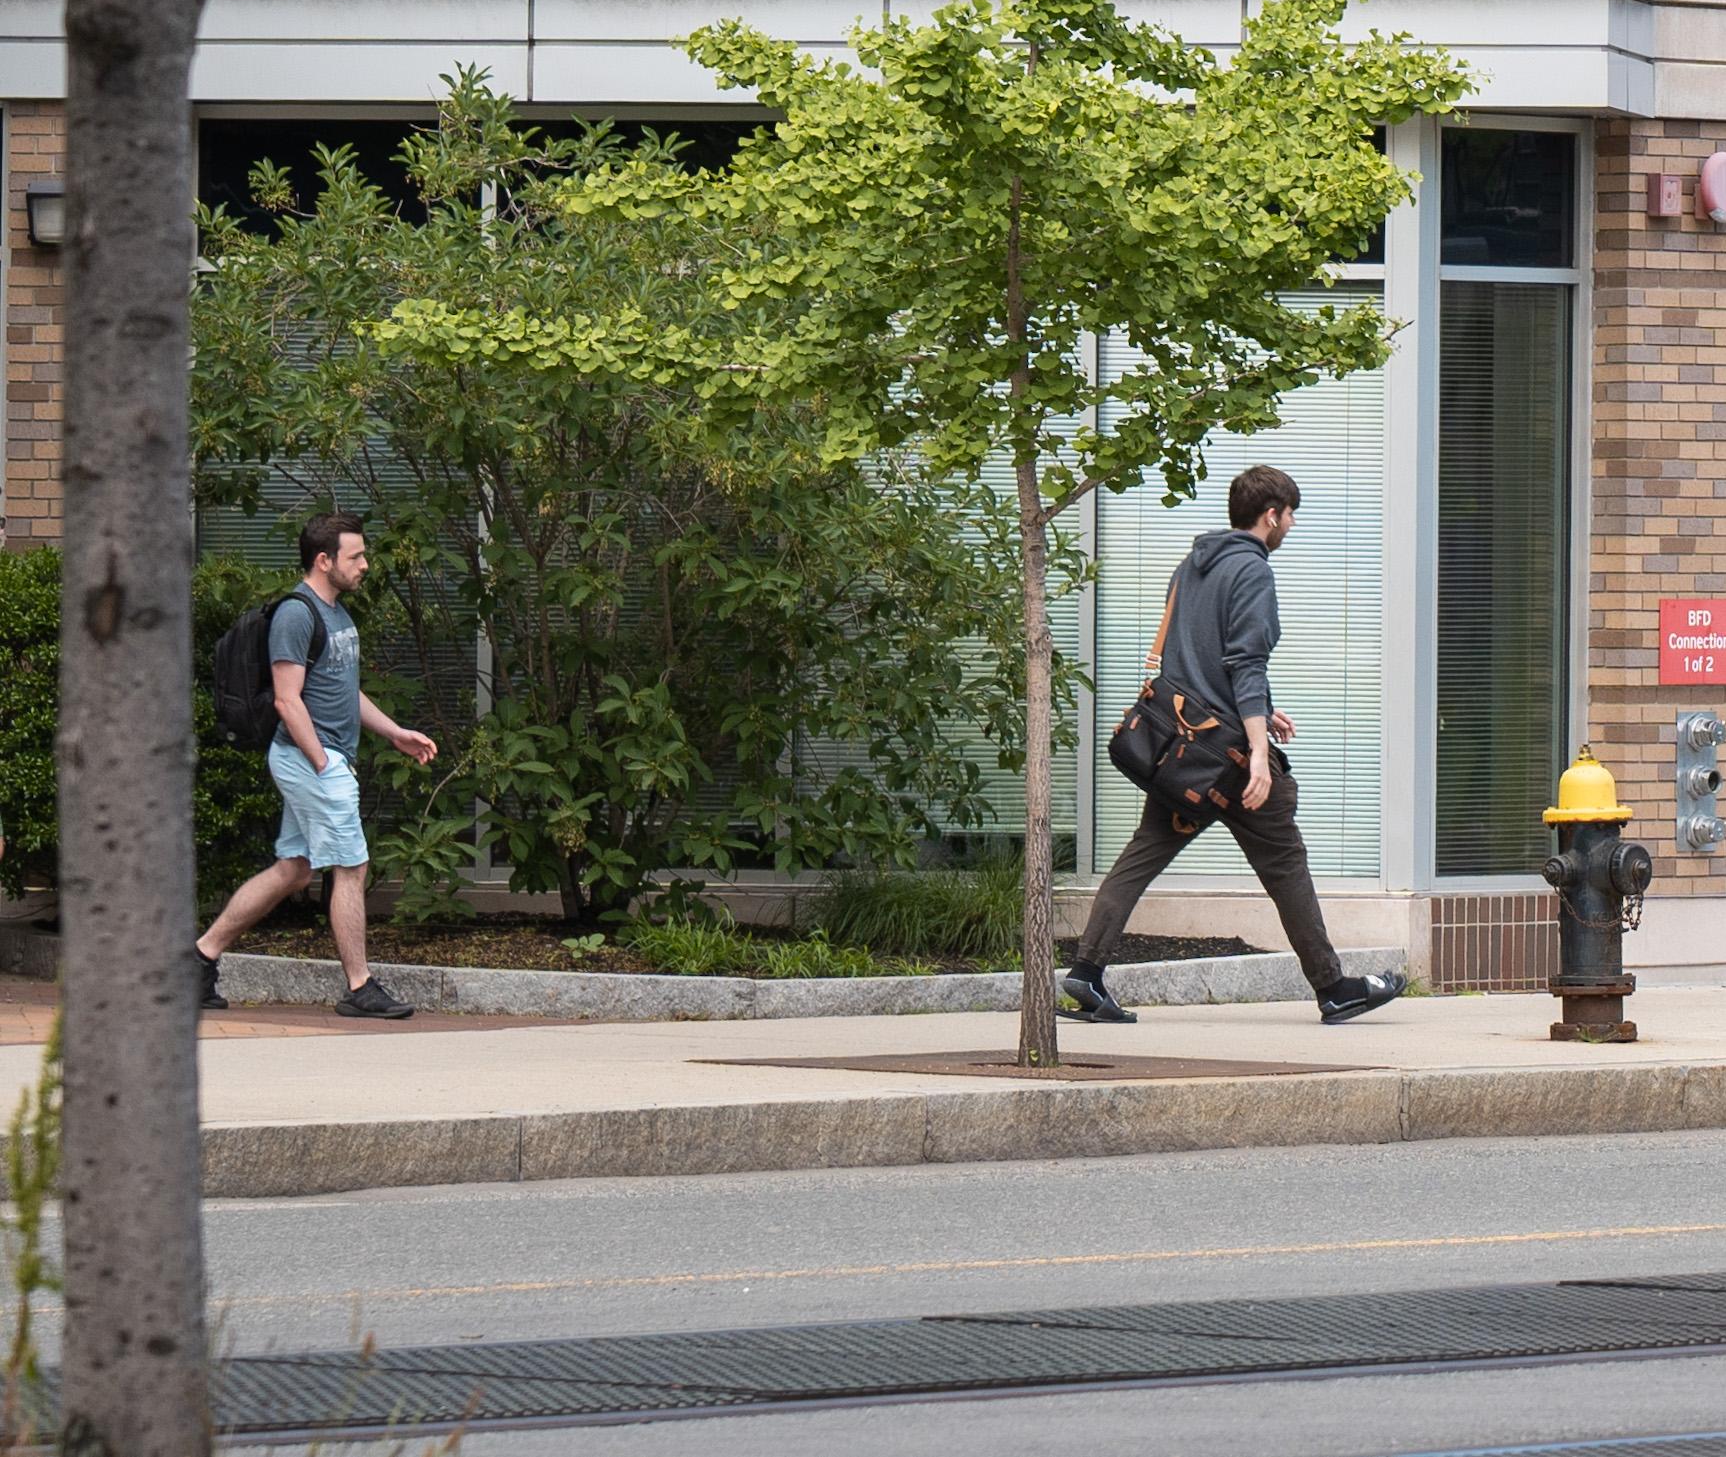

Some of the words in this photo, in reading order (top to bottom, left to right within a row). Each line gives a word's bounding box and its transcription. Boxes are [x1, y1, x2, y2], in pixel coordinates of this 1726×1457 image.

[1688, 610, 1711, 626] BFD
[1683, 657, 1690, 672] 1
[1691, 656, 1703, 672] of
[1704, 656, 1714, 672] 2
